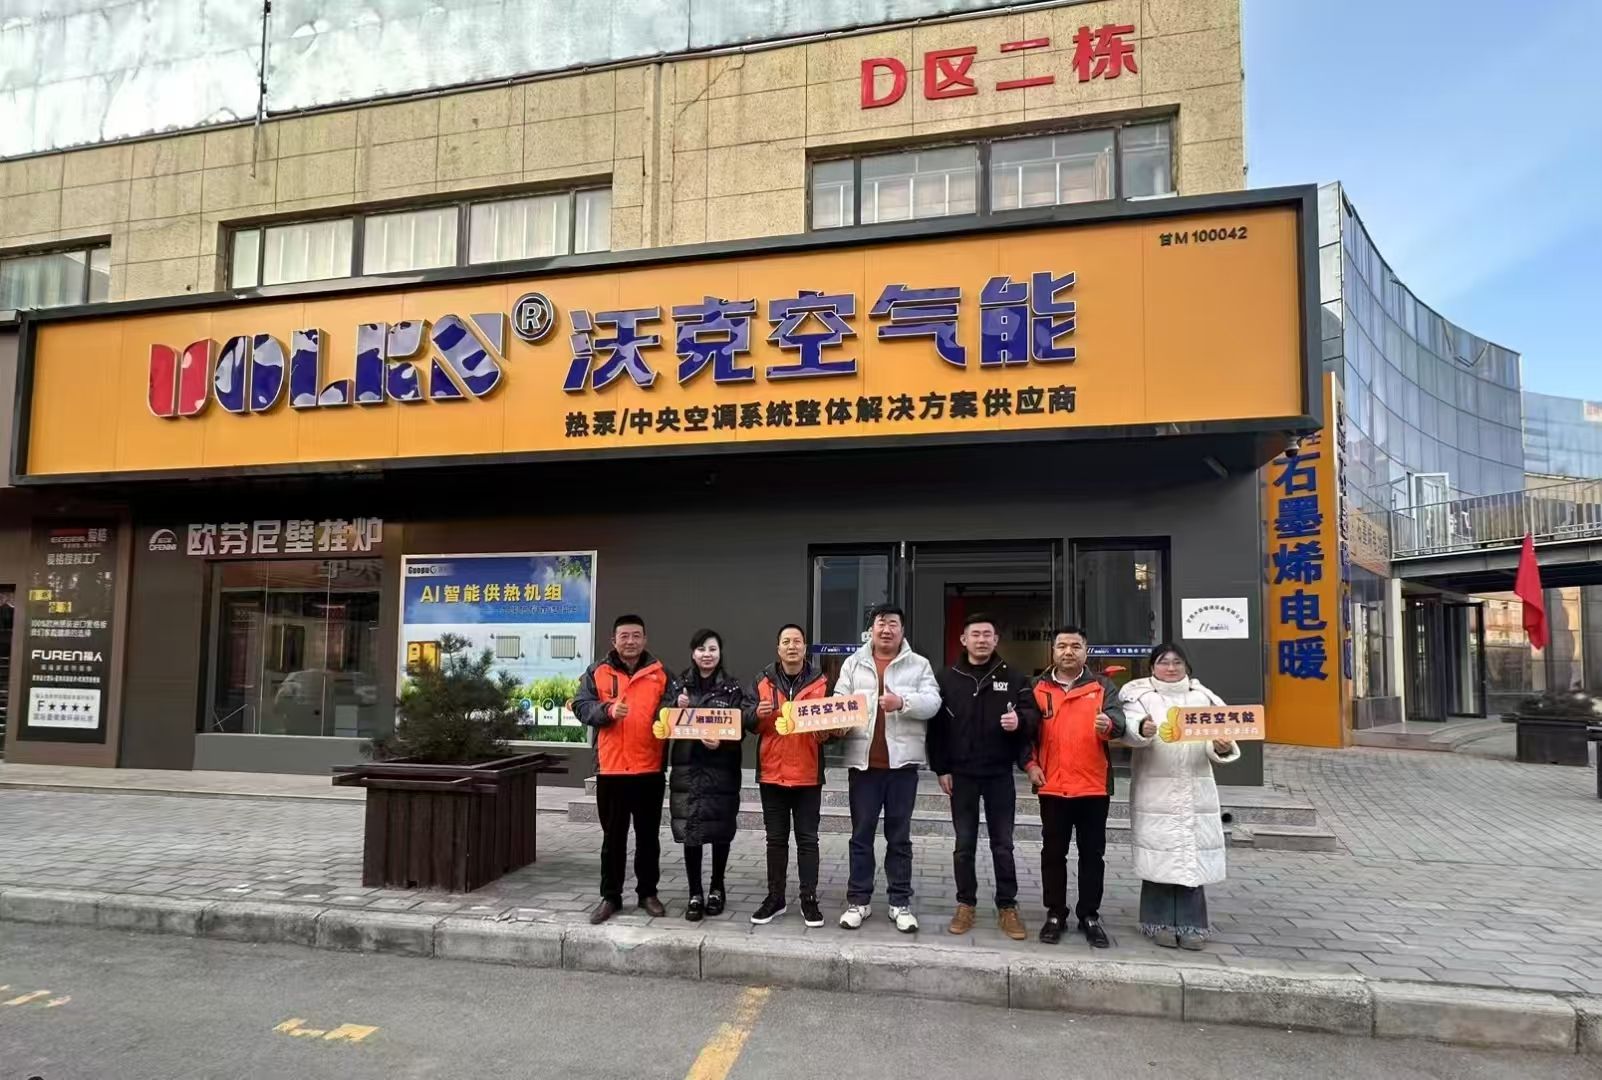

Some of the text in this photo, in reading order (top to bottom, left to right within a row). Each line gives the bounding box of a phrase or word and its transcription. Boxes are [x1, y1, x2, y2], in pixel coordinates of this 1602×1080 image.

[861, 24, 1138, 110] D区二栋
[562, 270, 1077, 393] 沃克空气能
[565, 385, 1077, 438] 热泵/中央空调系统整体解决方案供应商
[186, 516, 384, 556] 欧芬尼壁挂炉
[798, 700, 859, 717] 沃克空气能
[1184, 711, 1255, 724] 沃克空气能
